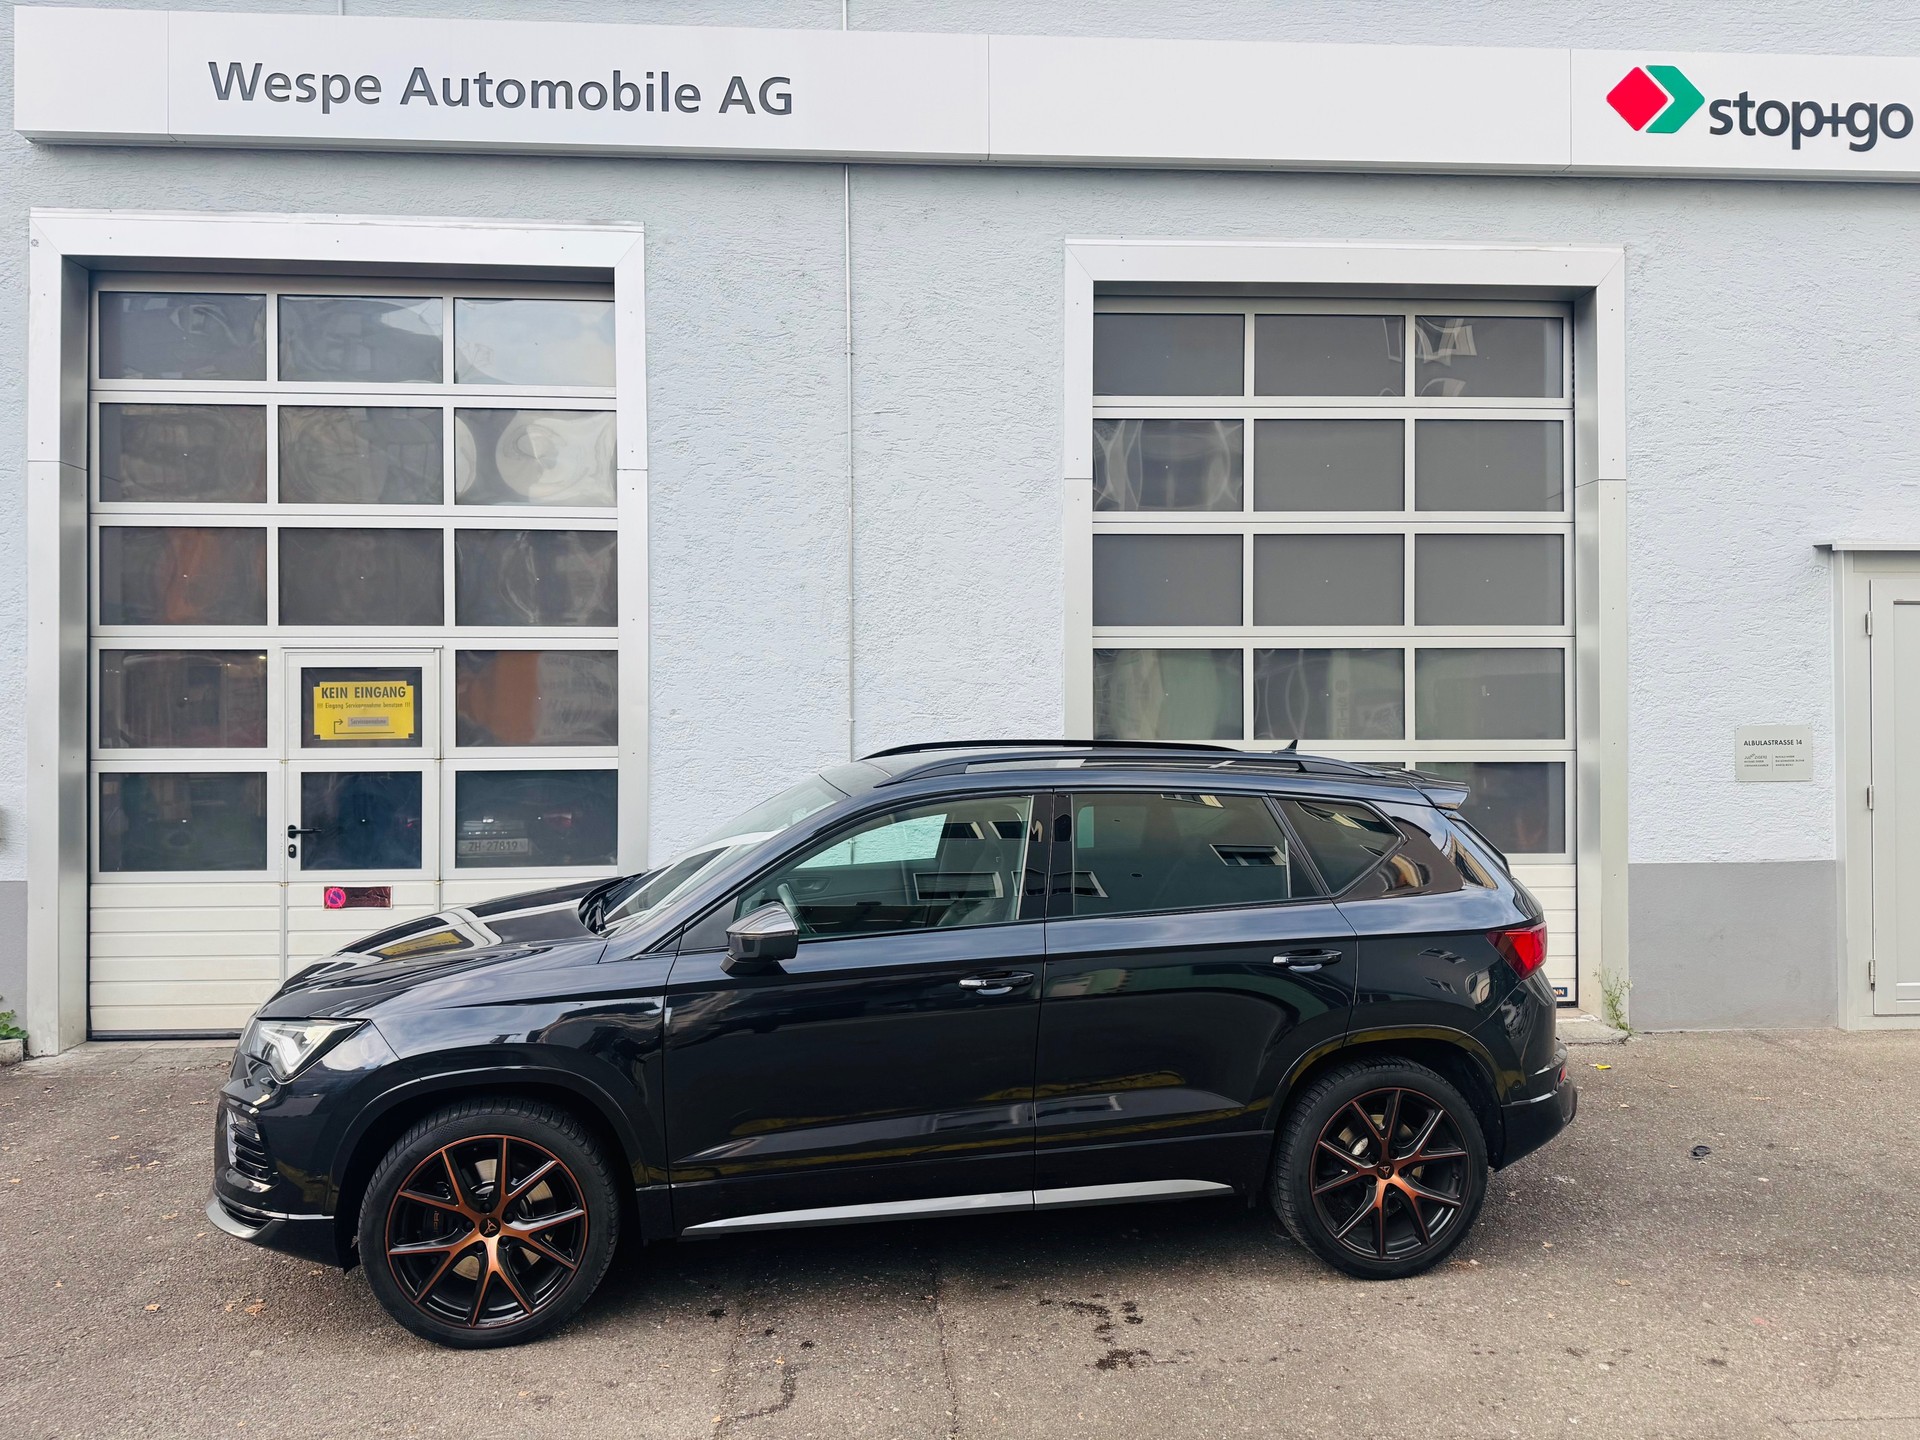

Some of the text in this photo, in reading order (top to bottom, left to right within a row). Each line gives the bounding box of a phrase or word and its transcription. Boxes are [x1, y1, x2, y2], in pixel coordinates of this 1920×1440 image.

[208, 62, 792, 115] Wespe Automobile AG
[1709, 91, 1913, 152] stop+go
[321, 686, 406, 699] KEIN EINGANG
